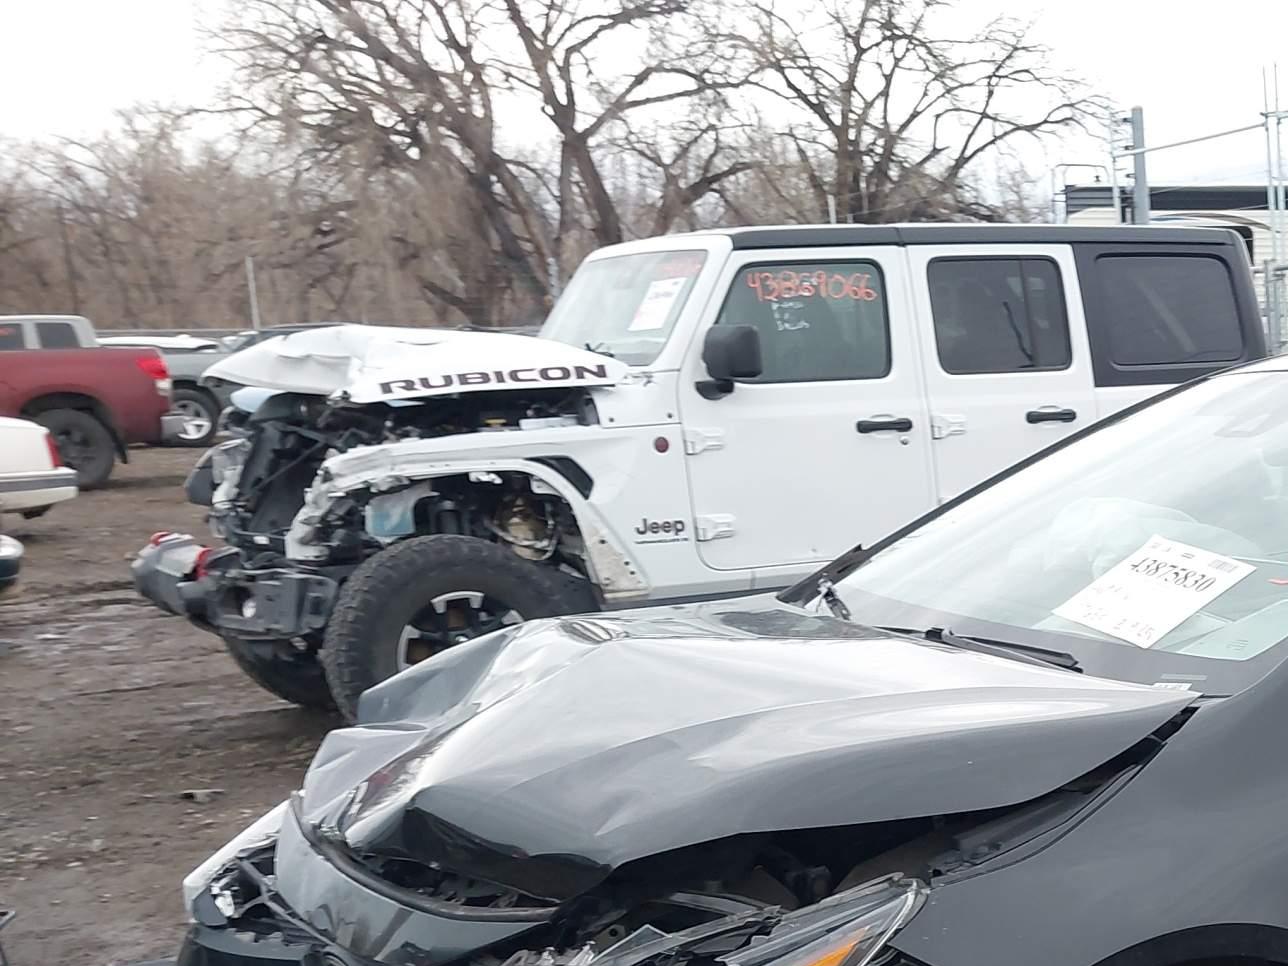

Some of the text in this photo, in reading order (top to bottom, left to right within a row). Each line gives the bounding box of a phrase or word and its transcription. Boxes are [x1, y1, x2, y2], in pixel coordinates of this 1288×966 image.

[747, 269, 878, 301] 43869066
[379, 364, 609, 395] RUBICON
[634, 517, 686, 537] Jeep
[1130, 556, 1217, 593] 43875830
